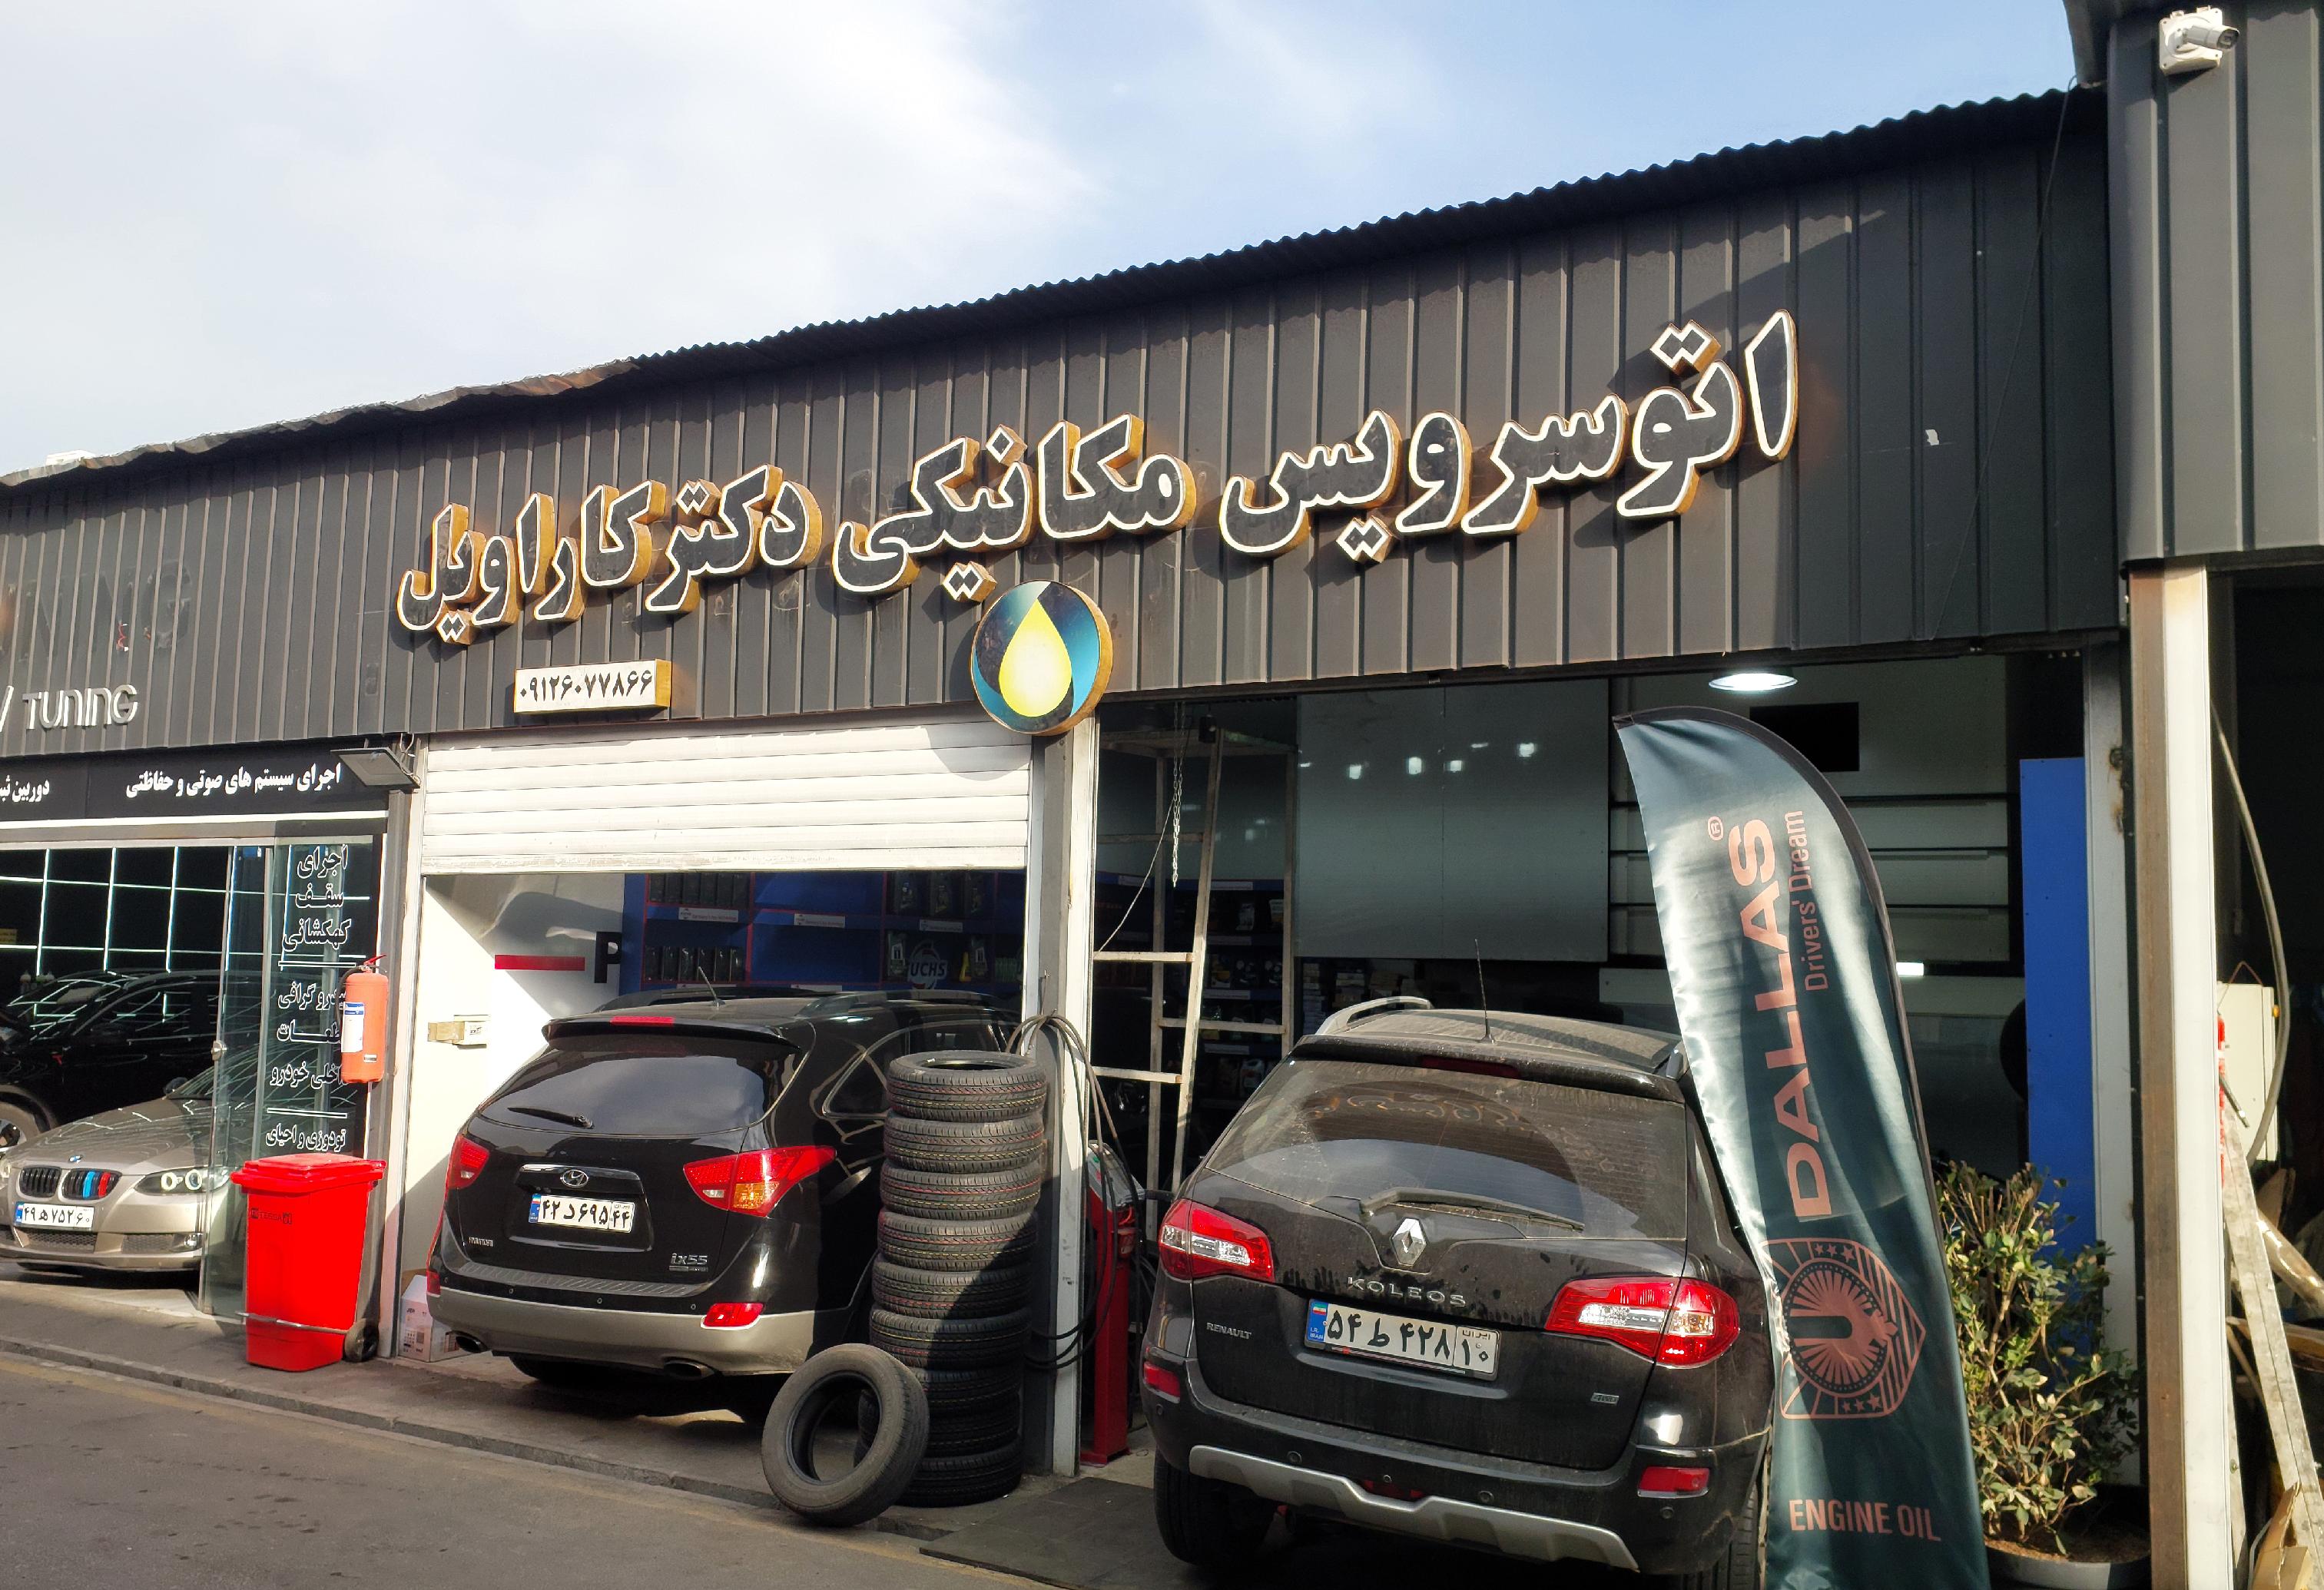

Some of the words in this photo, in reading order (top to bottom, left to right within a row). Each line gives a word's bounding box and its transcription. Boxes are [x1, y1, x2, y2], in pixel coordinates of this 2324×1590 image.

[832, 412, 1197, 603] مکانیکی
[645, 463, 823, 614] دکتر
[519, 668, 654, 702] ۰۹۱۲۶۰۷۷۸۶۶
[0, 774, 11, 803] ثب
[12, 779, 50, 803] دوربین
[125, 770, 174, 799] حفاظتی
[175, 778, 184, 797] و
[186, 769, 223, 797] صوتی
[224, 766, 253, 796] های
[254, 768, 294, 795] سیستم
[297, 762, 342, 792] اجرای
[297, 843, 349, 879] اجرای
[1784, 810, 1812, 893] Dream
[295, 882, 344, 909] سقف
[282, 917, 352, 952] کهکشانی
[1791, 899, 1829, 992] Drivers'
[910, 961, 948, 978] UCHS
[278, 980, 317, 1011] گرافی
[276, 1019, 343, 1045] طعات
[1728, 818, 1832, 1223] DALLAS
[269, 1060, 310, 1088] خودرو
[310, 1061, 350, 1089] اخلی
[265, 1122, 297, 1147] احیای
[297, 1131, 305, 1149] و
[305, 1128, 346, 1152] تودوزی
[1347, 1277, 1466, 1307] KOLEOS
[1206, 1322, 1252, 1340] RENAULT
[1789, 1499, 1893, 1534] ENGINE
[1896, 1505, 1942, 1542] OIL
